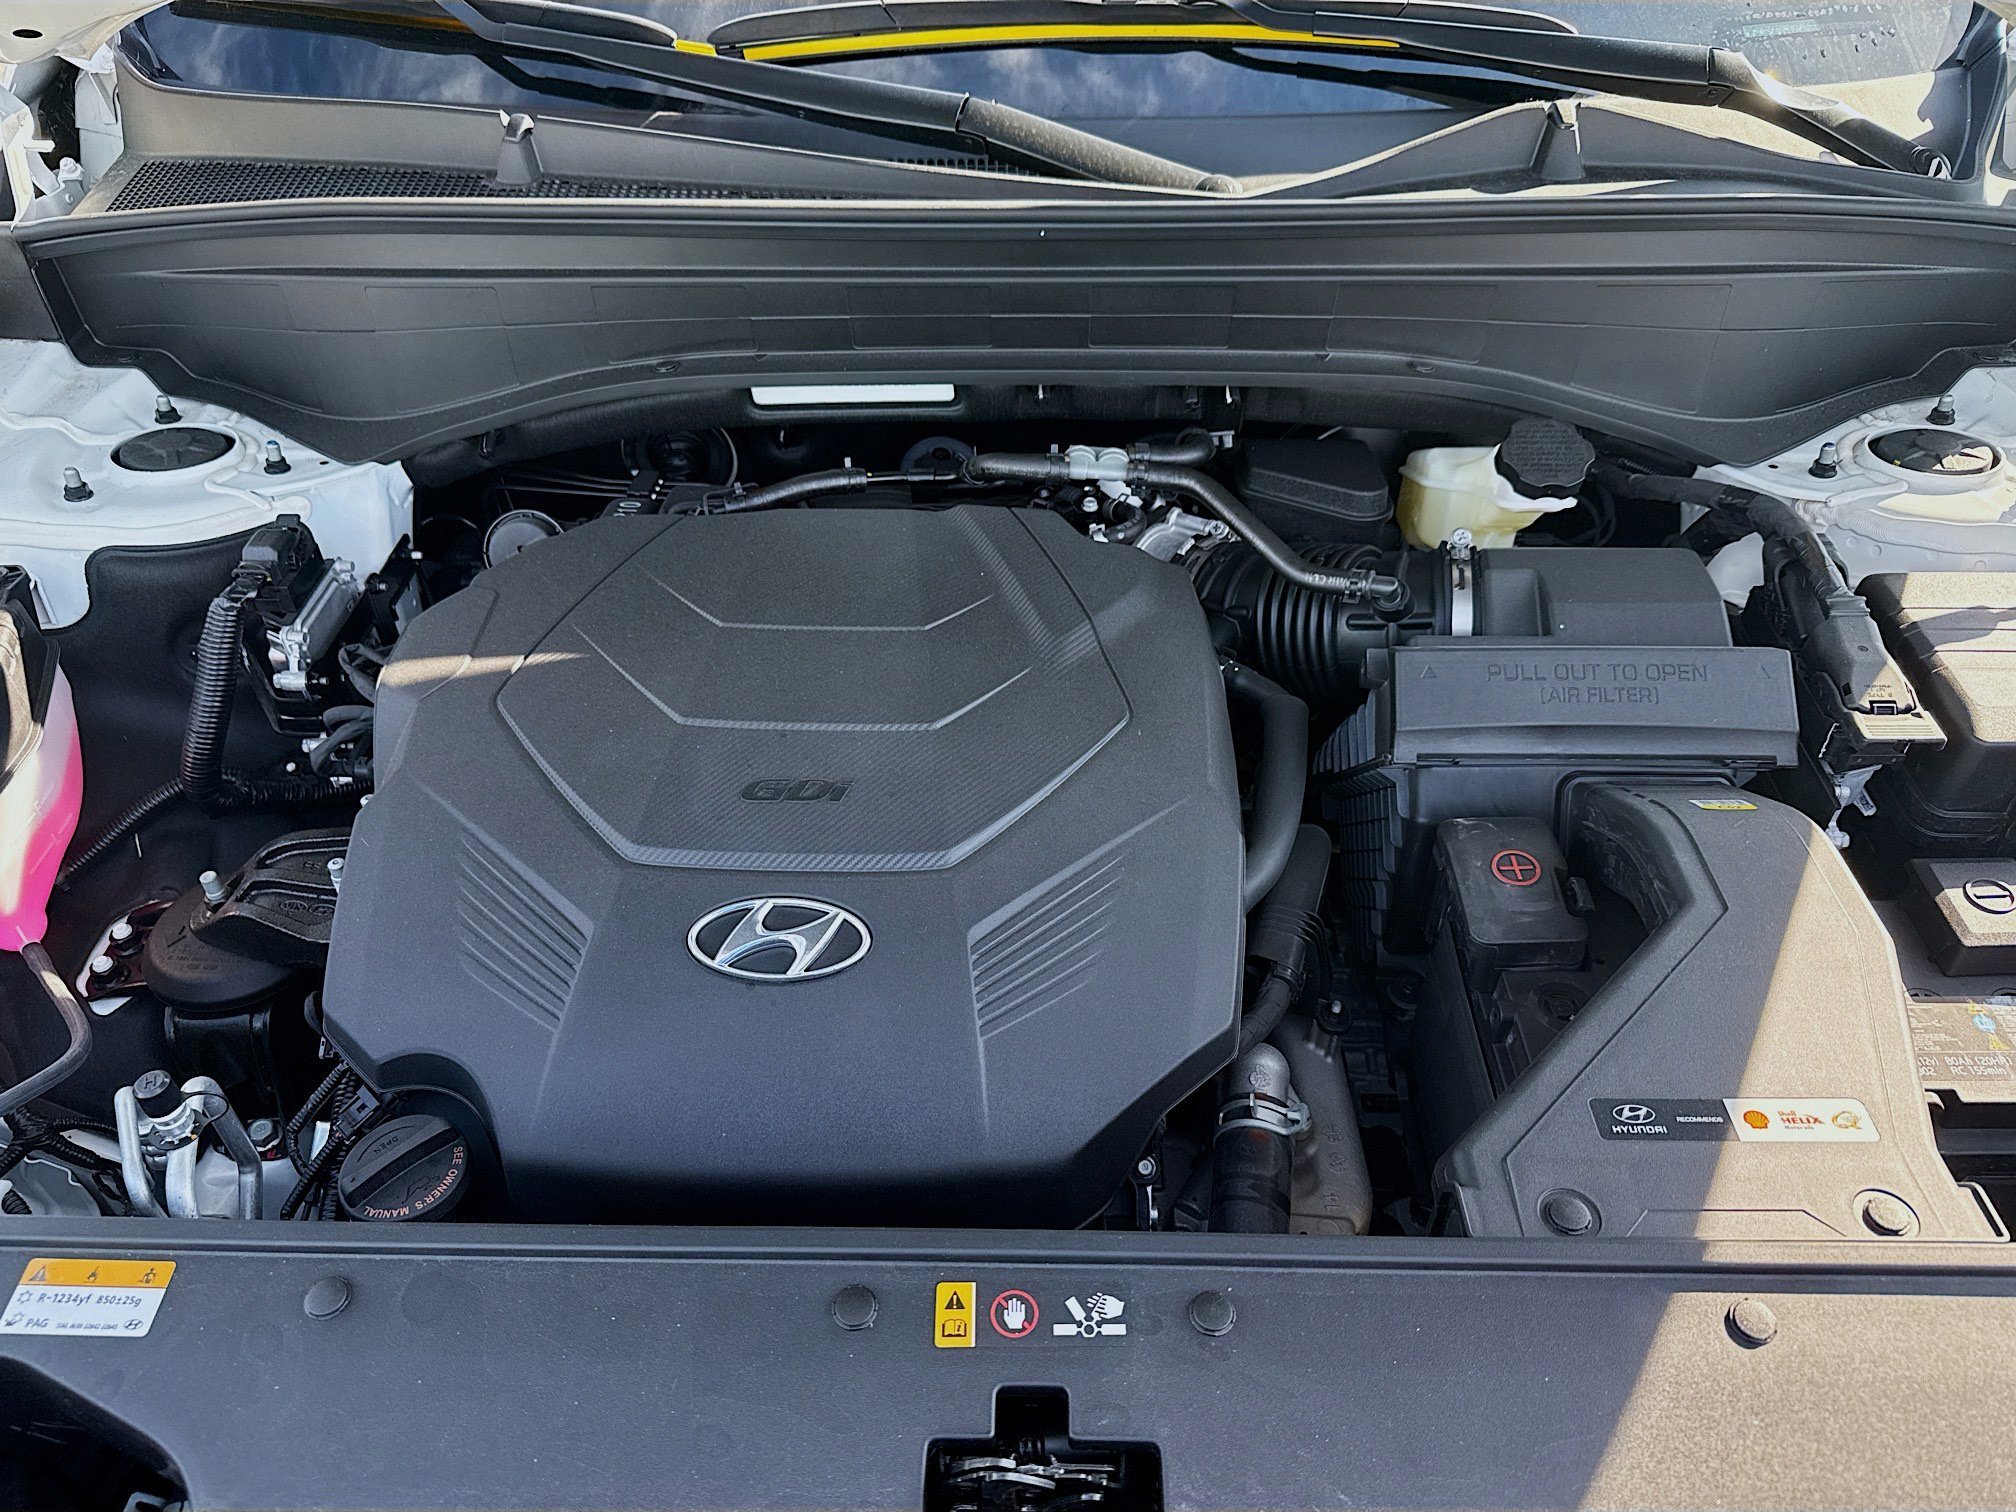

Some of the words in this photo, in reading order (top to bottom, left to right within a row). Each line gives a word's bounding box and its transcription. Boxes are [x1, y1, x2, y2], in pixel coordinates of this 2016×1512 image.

[1487, 663, 1547, 682] PULL
[1554, 663, 1600, 682] OUT
[1607, 663, 1638, 682] TO
[1645, 663, 1708, 682] OPEN
[1540, 686, 1581, 704] (AIR
[1587, 686, 1660, 705] FILTER)
[1950, 1066, 1968, 1076] RC
[143, 1075, 157, 1090] H
[1781, 1116, 1824, 1125] HELIX
[1611, 1125, 1668, 1135] HYUNDAI
[373, 1135, 399, 1155] OPEN
[452, 1146, 464, 1165] SEE
[414, 1168, 458, 1210] OWNER'S
[364, 1205, 410, 1219] MANUAL
[38, 1293, 93, 1306] R-1234yf
[96, 1295, 143, 1308] 850±25g
[25, 1317, 50, 1328] PAG
